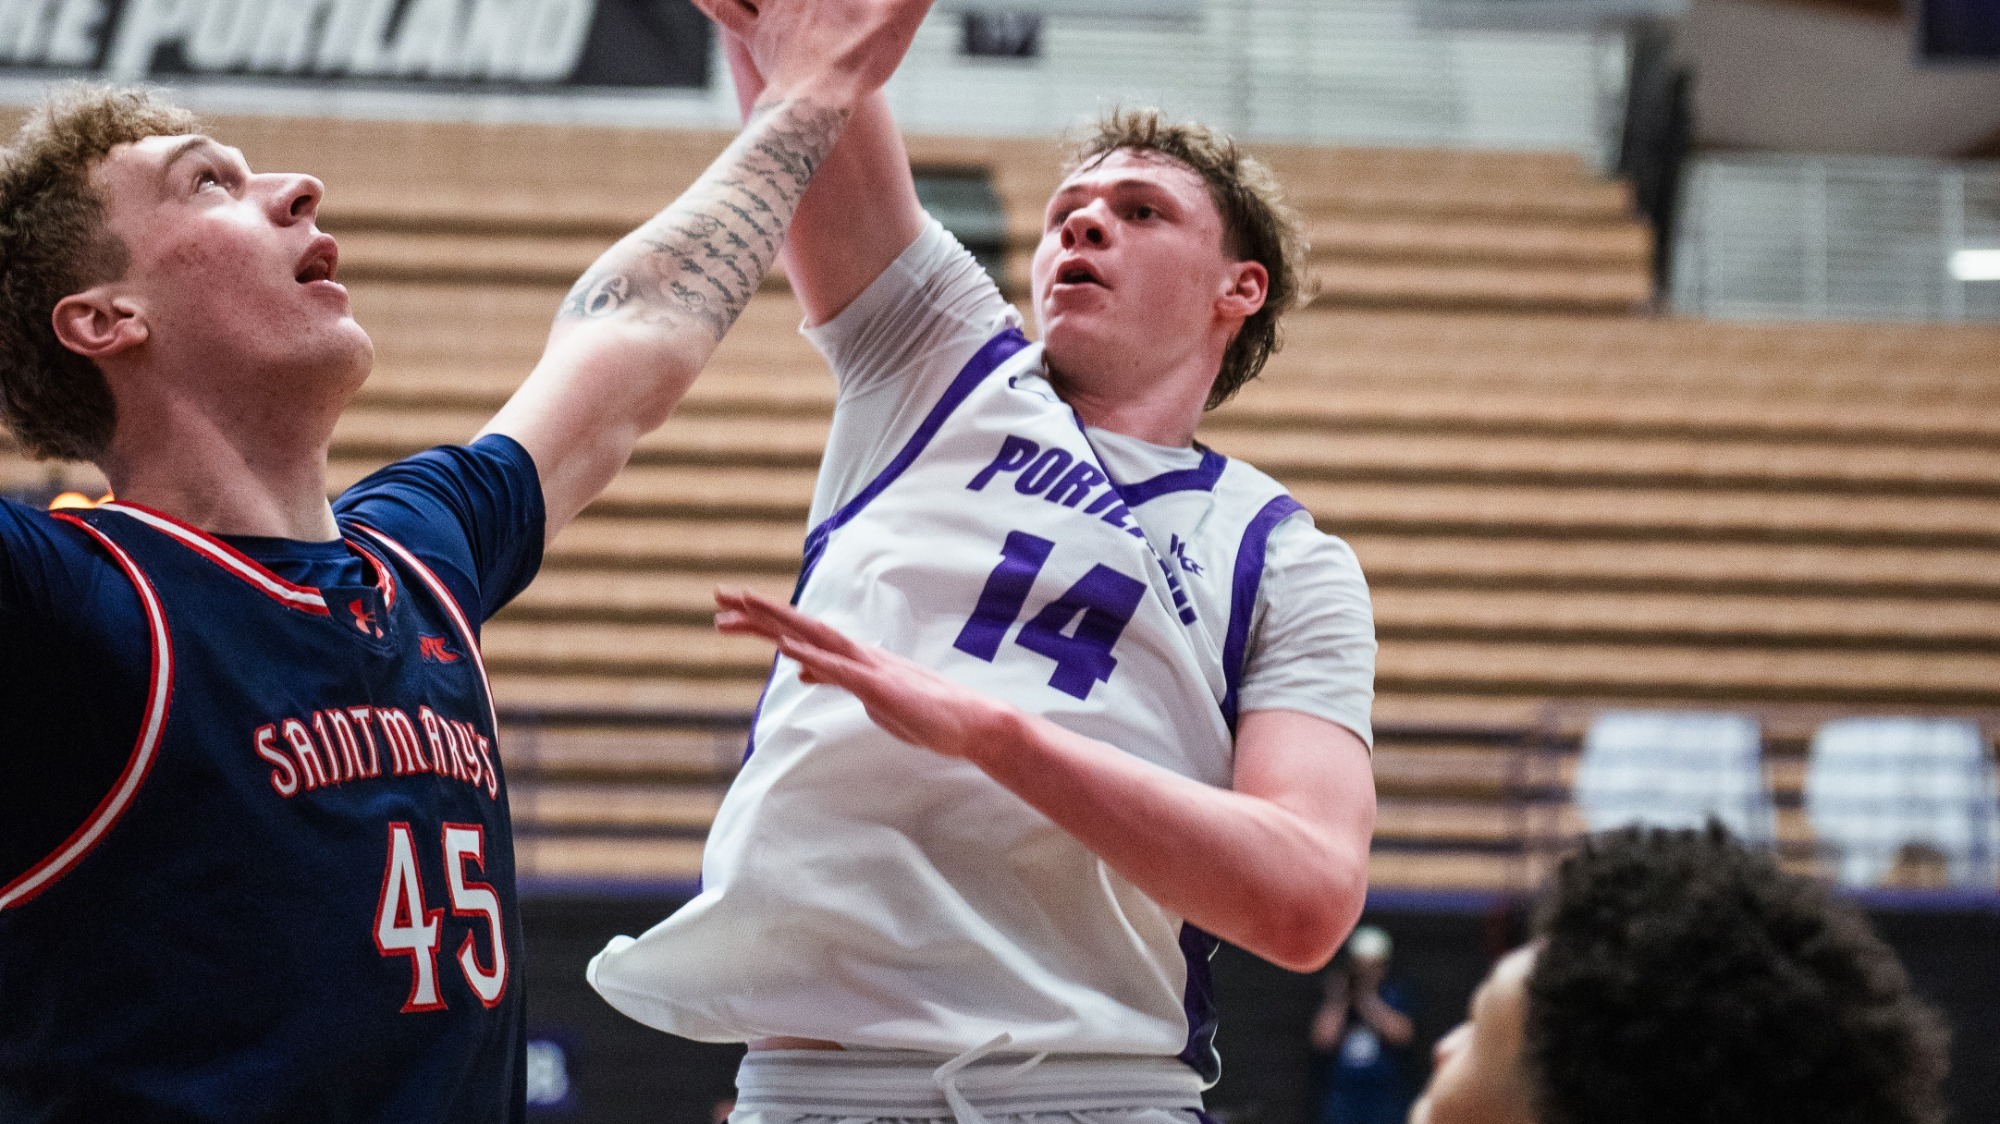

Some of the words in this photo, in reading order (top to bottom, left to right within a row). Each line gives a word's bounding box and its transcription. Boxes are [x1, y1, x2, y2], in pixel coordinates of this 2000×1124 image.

[952, 529, 1148, 702] 14
[254, 705, 381, 799] SAINT
[372, 821, 509, 1013] 45
